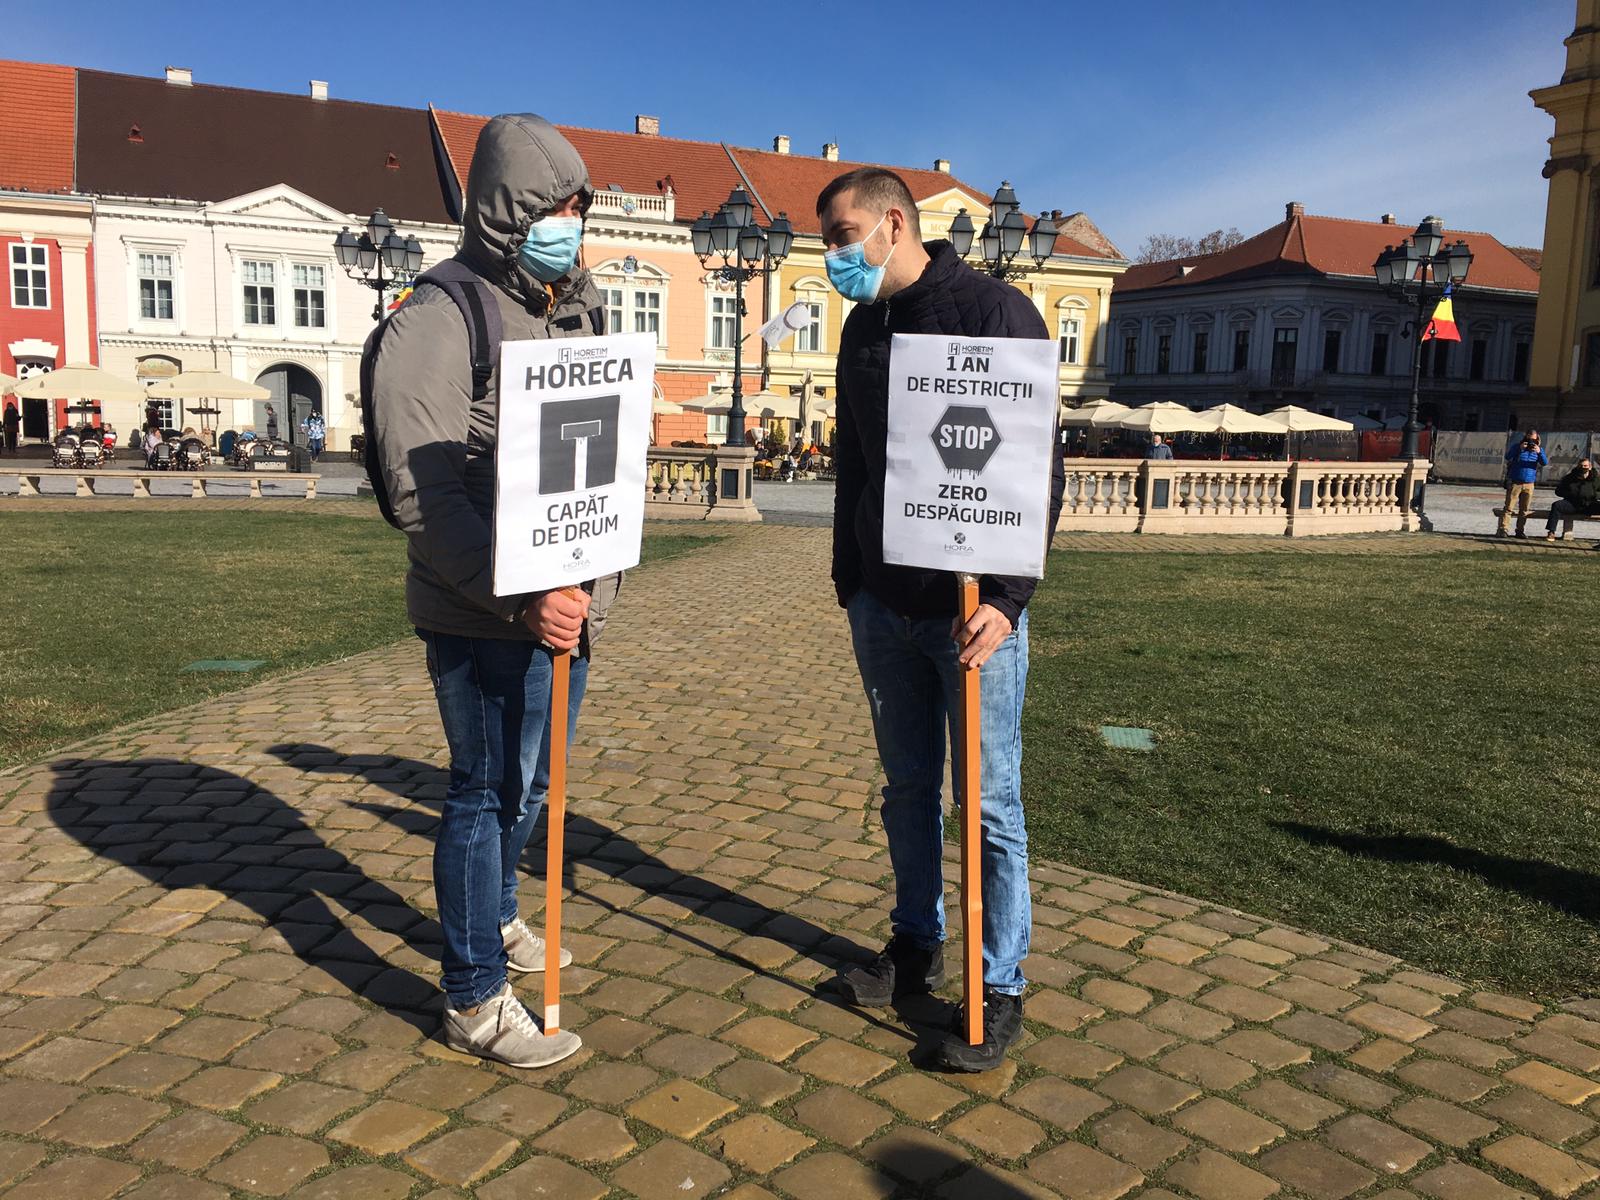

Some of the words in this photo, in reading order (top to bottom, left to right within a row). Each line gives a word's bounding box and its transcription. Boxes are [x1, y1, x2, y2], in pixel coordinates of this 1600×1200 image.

[574, 347, 608, 357] HORETIM
[962, 345, 994, 353] HORETIM
[946, 356, 957, 371] 1
[961, 357, 990, 372] AN
[525, 358, 634, 390] HORECA
[907, 377, 929, 392] DE
[939, 424, 993, 450] STOP
[938, 484, 987, 502] ZERO
[547, 494, 609, 523] CAPĂT
[904, 503, 1022, 527] DESPĂGUBIRI
[532, 525, 559, 547] DE
[565, 514, 618, 542] DRUM
[944, 544, 975, 552] HORA
